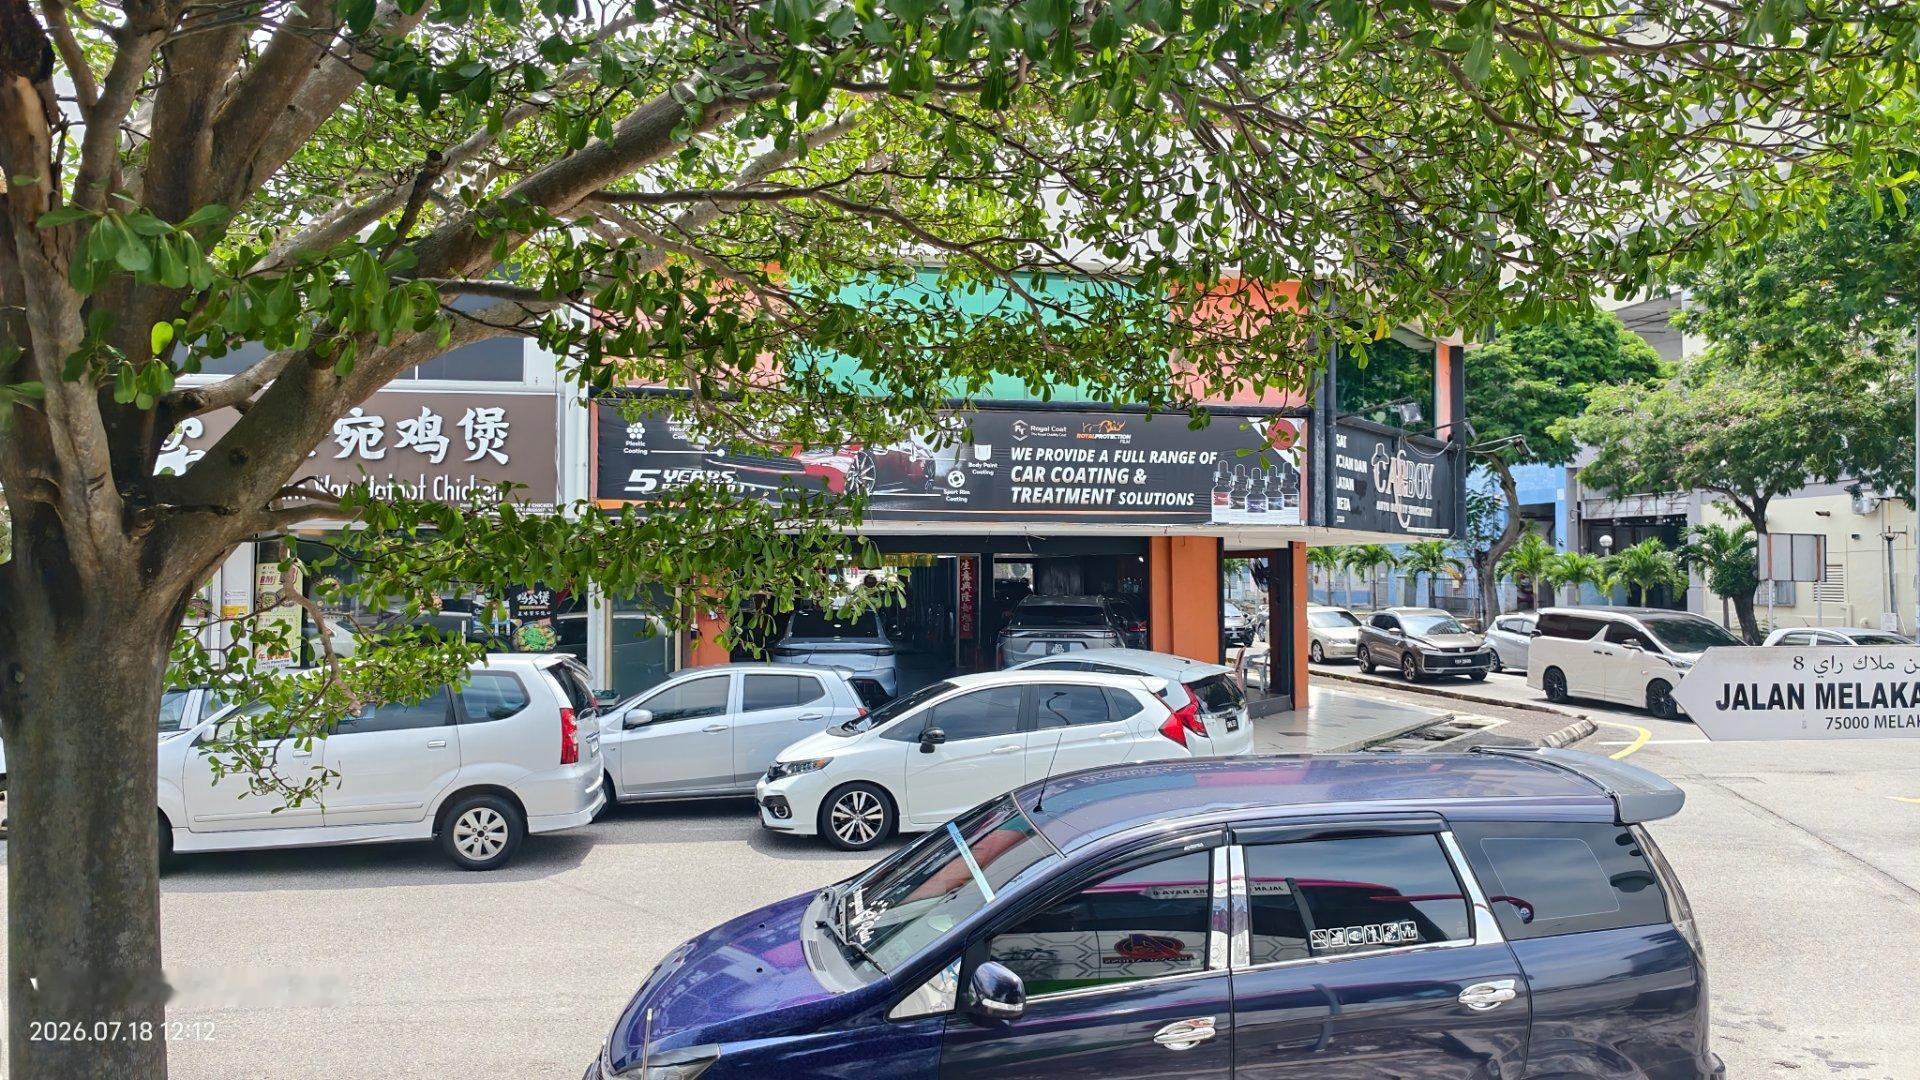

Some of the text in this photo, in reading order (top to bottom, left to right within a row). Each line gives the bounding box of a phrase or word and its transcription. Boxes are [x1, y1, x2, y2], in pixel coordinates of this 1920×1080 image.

[307, 406, 510, 465] 宛鸡煲
[1030, 425, 1050, 433] Royal
[1011, 447, 1218, 465] WE PROVIDE A FULL RANGE OF
[624, 469, 661, 492] 5
[1011, 466, 1147, 486] CAR COATING &
[1011, 487, 1195, 506] TREATMENT SOLUTIONS
[1793, 655, 1804, 671] 8
[1813, 655, 1844, 679] راي
[1715, 682, 1805, 711] JALAN
[1825, 716, 1870, 730] 75000
[1401, 929, 1416, 939] VIP
